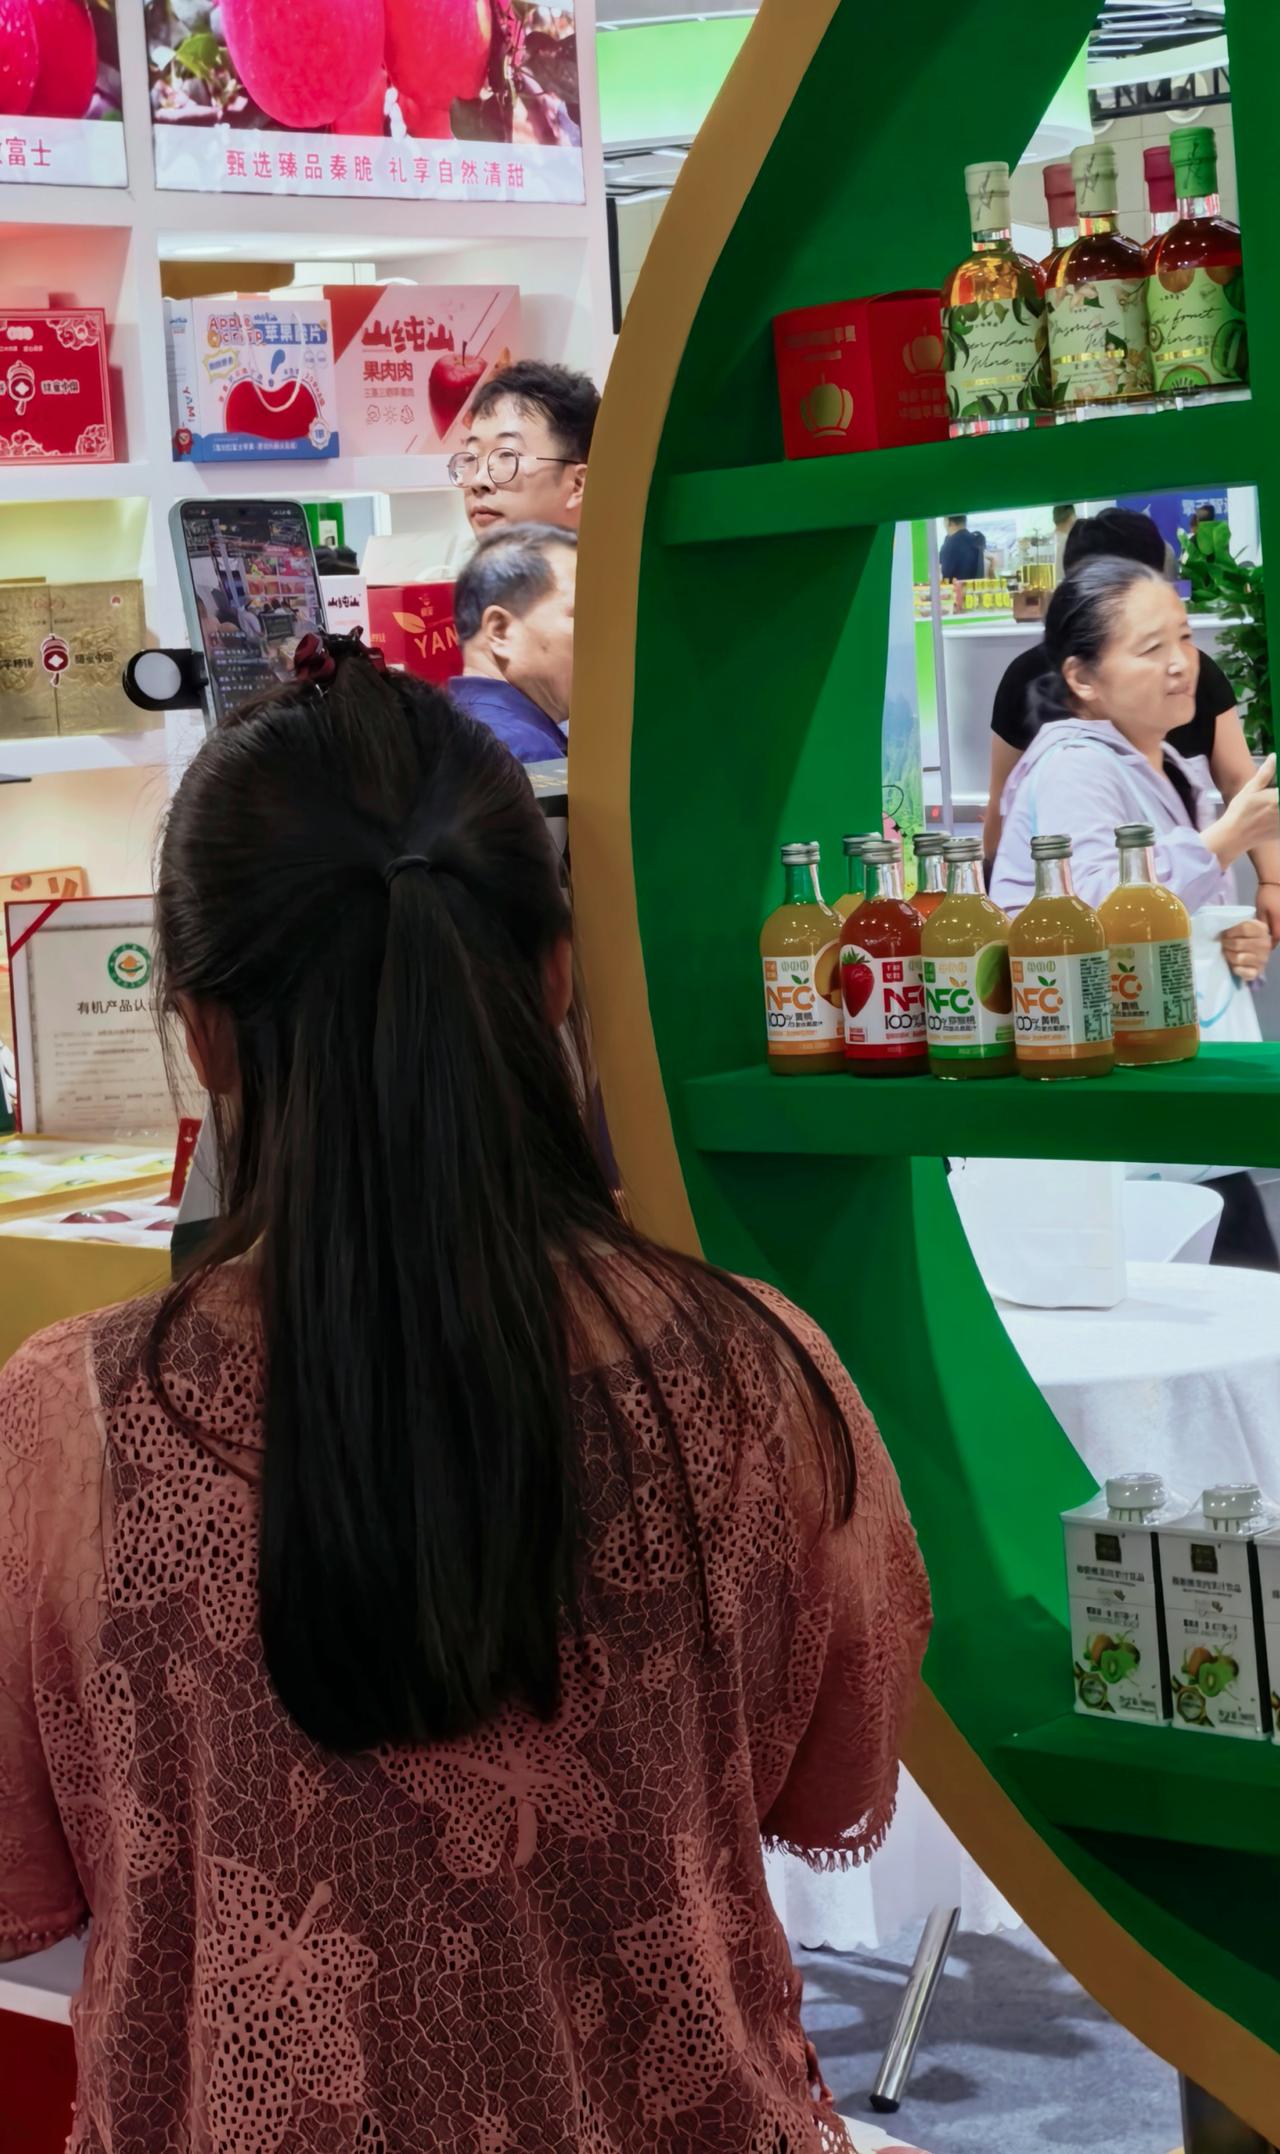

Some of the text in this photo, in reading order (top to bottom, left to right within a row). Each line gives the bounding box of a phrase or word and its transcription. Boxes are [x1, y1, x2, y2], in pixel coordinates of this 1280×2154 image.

[0, 136, 51, 167] 富士
[226, 149, 525, 188] 甄选臻品秦脆 礼享自然清甜
[363, 360, 414, 382] 果肉肉
[767, 985, 814, 1011] NFC
[1014, 987, 1061, 1014] NFC
[1110, 975, 1139, 1000] FC
[926, 988, 971, 1014] NFC
